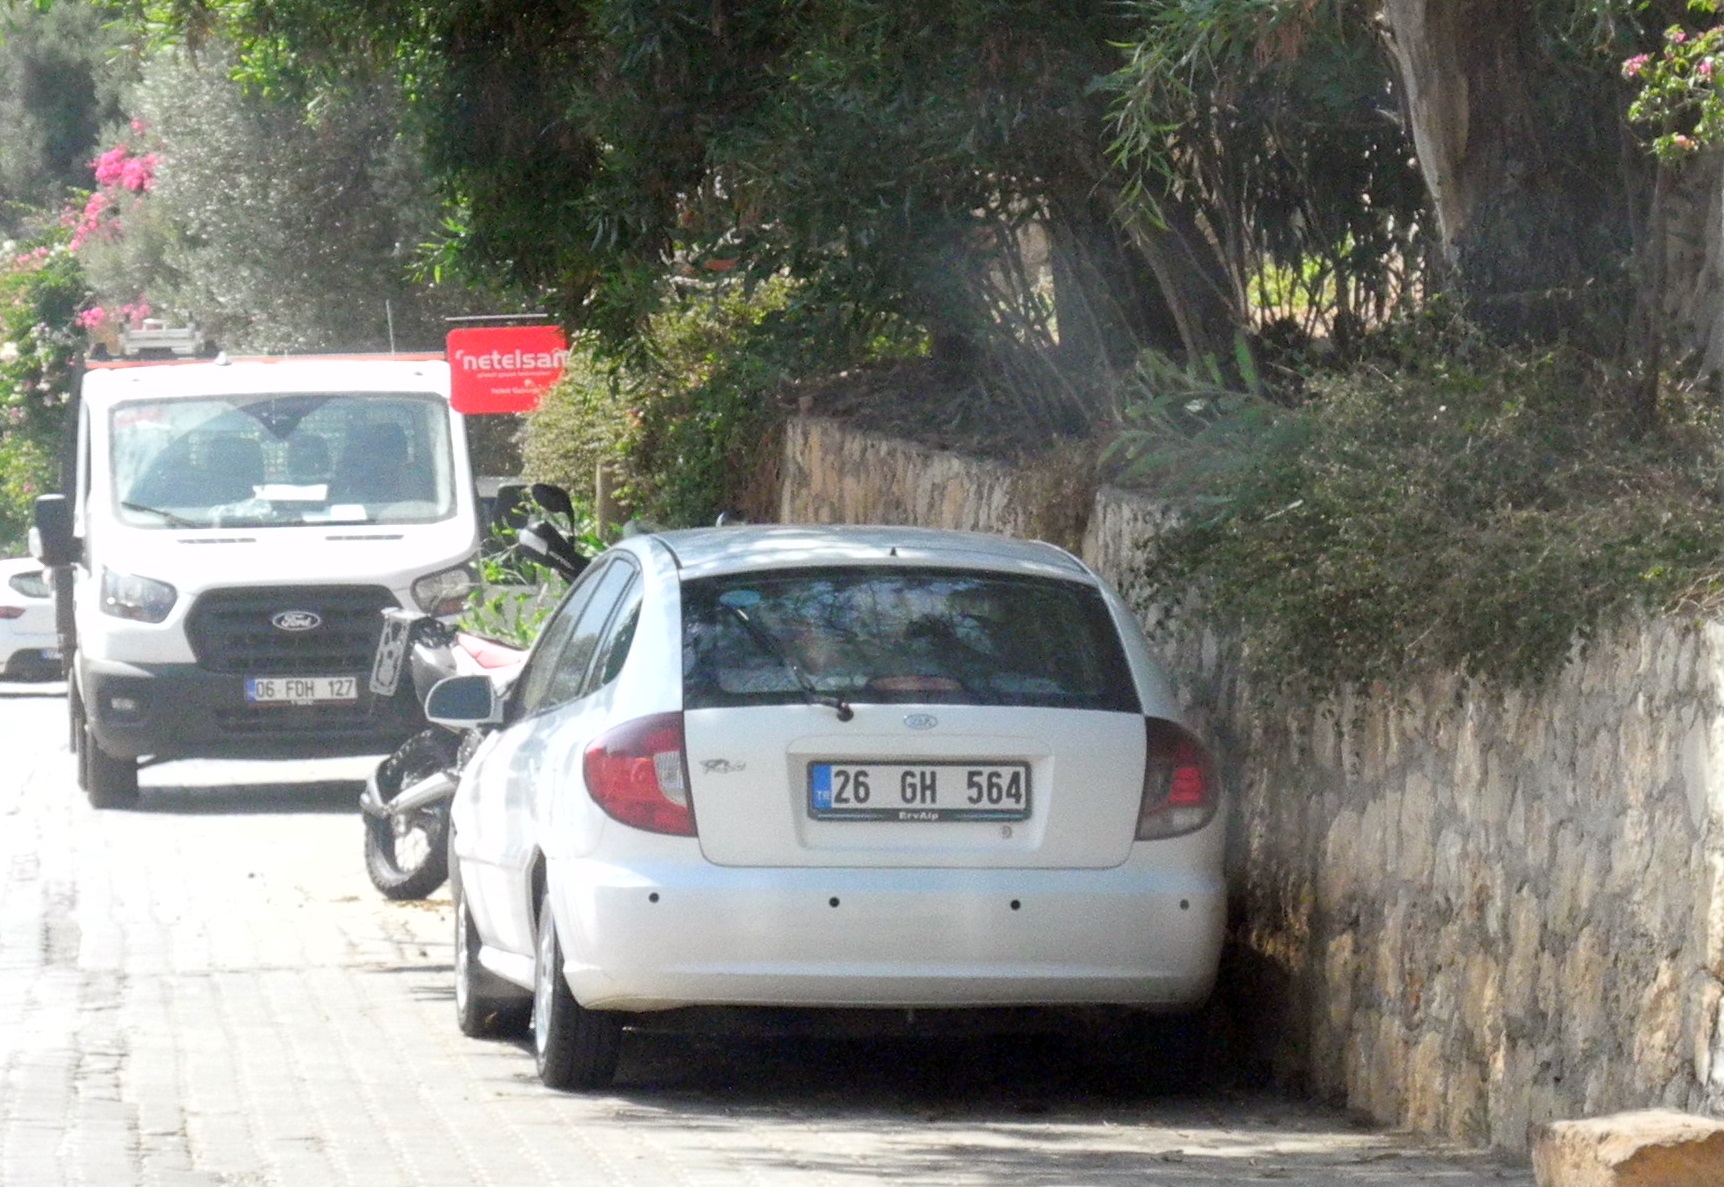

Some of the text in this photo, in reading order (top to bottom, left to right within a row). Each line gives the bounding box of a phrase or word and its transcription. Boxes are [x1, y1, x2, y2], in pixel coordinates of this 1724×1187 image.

[256, 681, 275, 698] 06
[328, 679, 353, 697] 127
[834, 770, 870, 804] 26
[900, 770, 937, 804] GH
[967, 770, 1022, 805] 564
